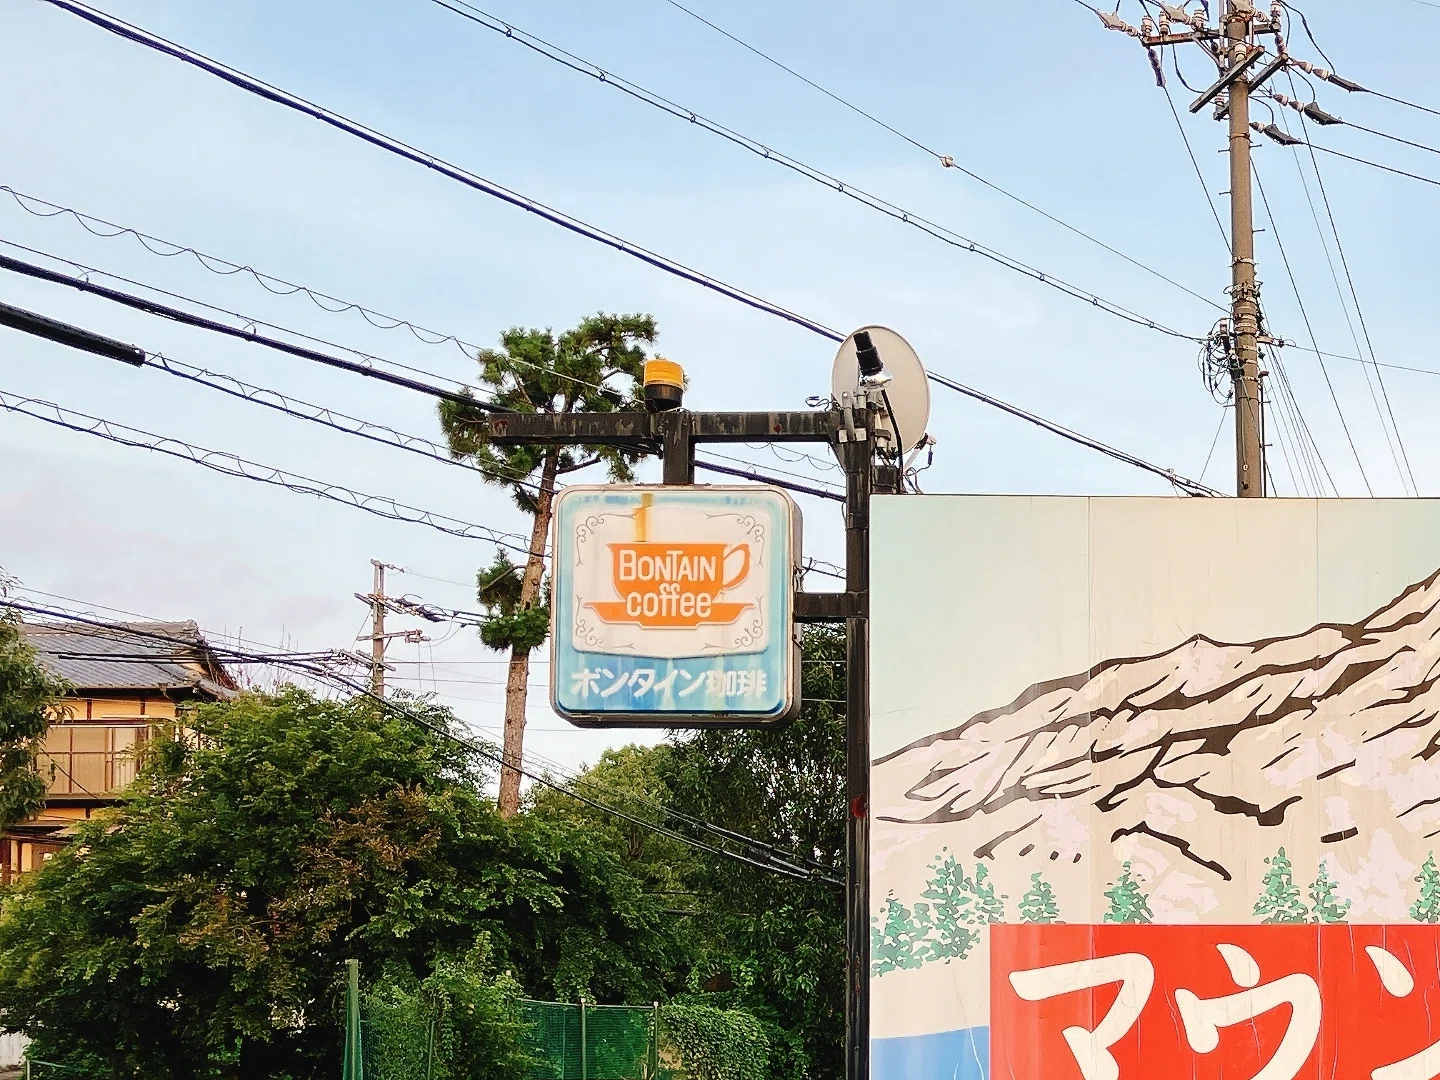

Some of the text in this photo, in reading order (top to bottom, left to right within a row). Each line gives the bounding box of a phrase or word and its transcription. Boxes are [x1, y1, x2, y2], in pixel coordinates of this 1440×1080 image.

[626, 583, 712, 618] coffee
[572, 667, 768, 698] ボンタイン珈琲
